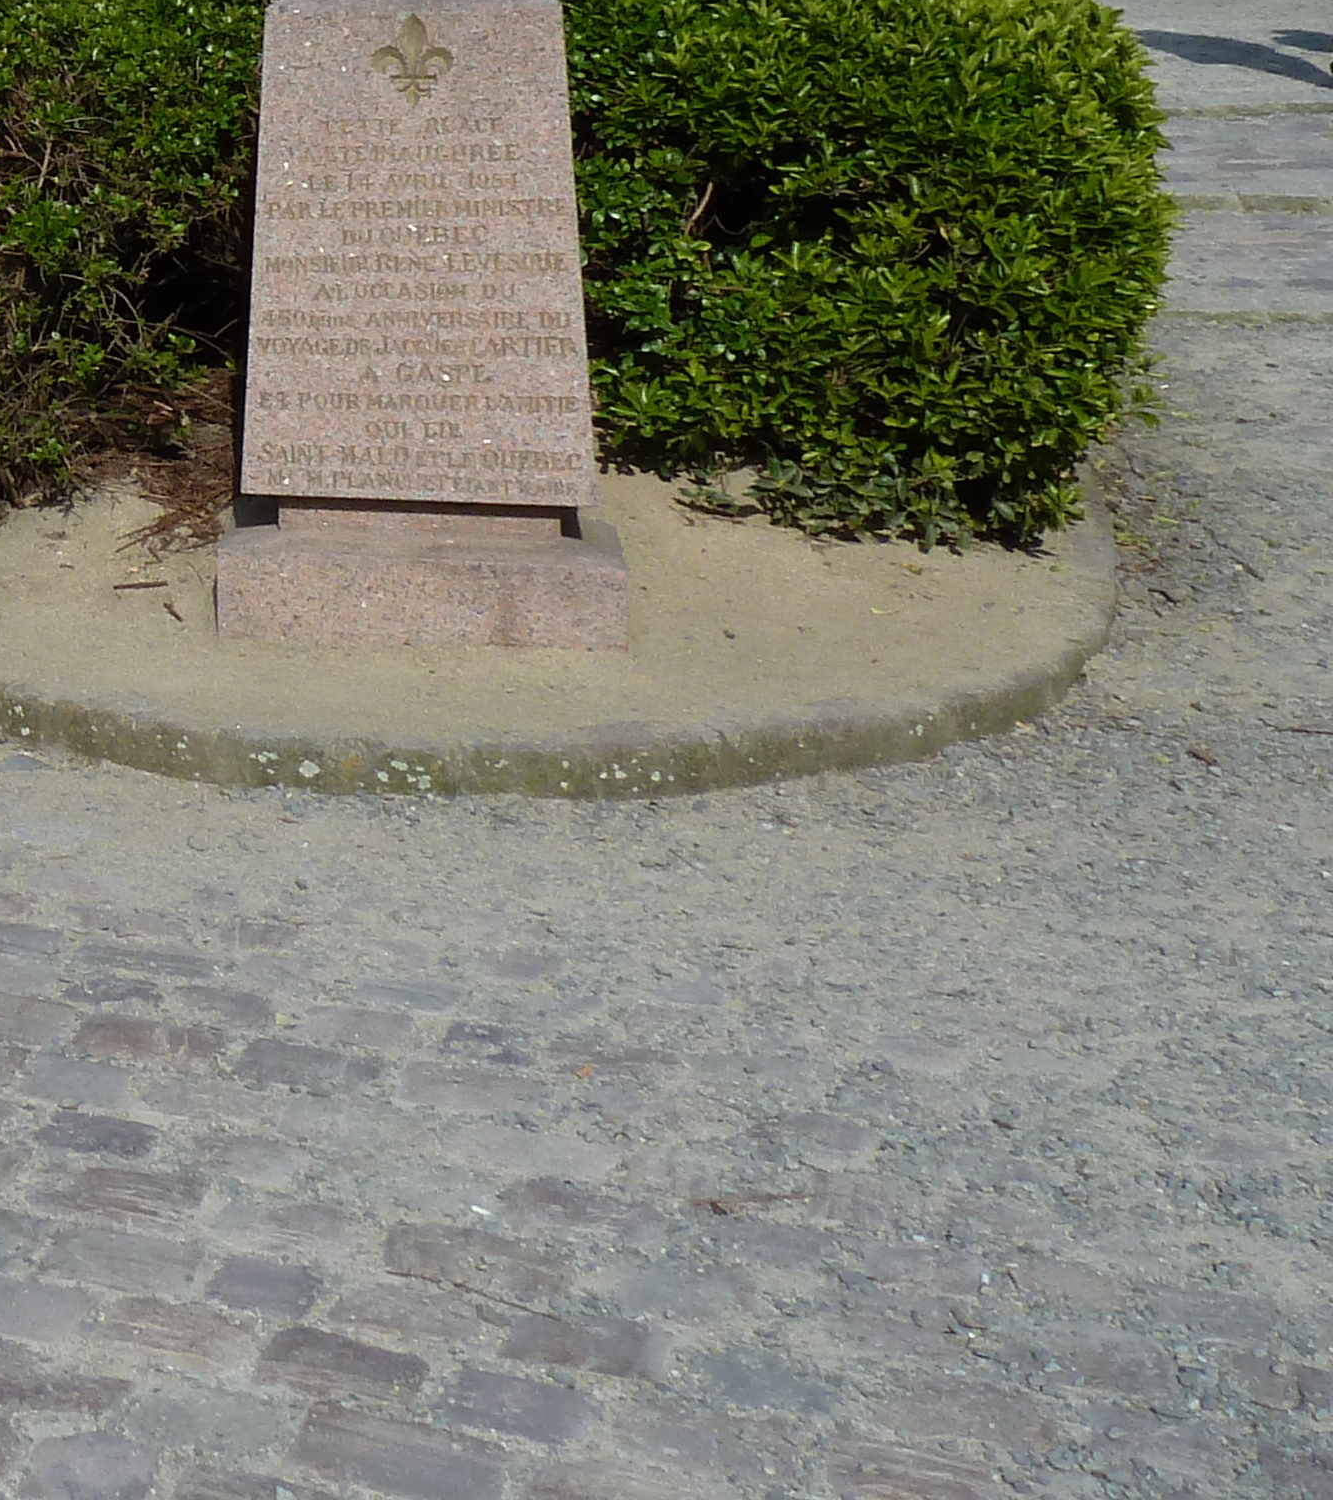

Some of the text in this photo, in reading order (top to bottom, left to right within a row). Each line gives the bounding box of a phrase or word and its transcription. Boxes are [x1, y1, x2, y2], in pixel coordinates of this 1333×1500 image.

[384, 172, 448, 190] AVRIL
[267, 198, 568, 220] PAR LE PREMIER MINISTRE
[342, 228, 373, 247] DU
[266, 255, 369, 274] MONSIEUR
[482, 284, 515, 298] DU
[365, 310, 528, 329] ANNIVERSAIRE
[256, 336, 345, 355] VOYAGE
[346, 338, 370, 355] DE
[470, 334, 577, 356] CARTIER
[259, 392, 290, 410] ET
[299, 392, 360, 410] POUR
[366, 392, 481, 411] MARQUER
[365, 421, 408, 438] QUI
